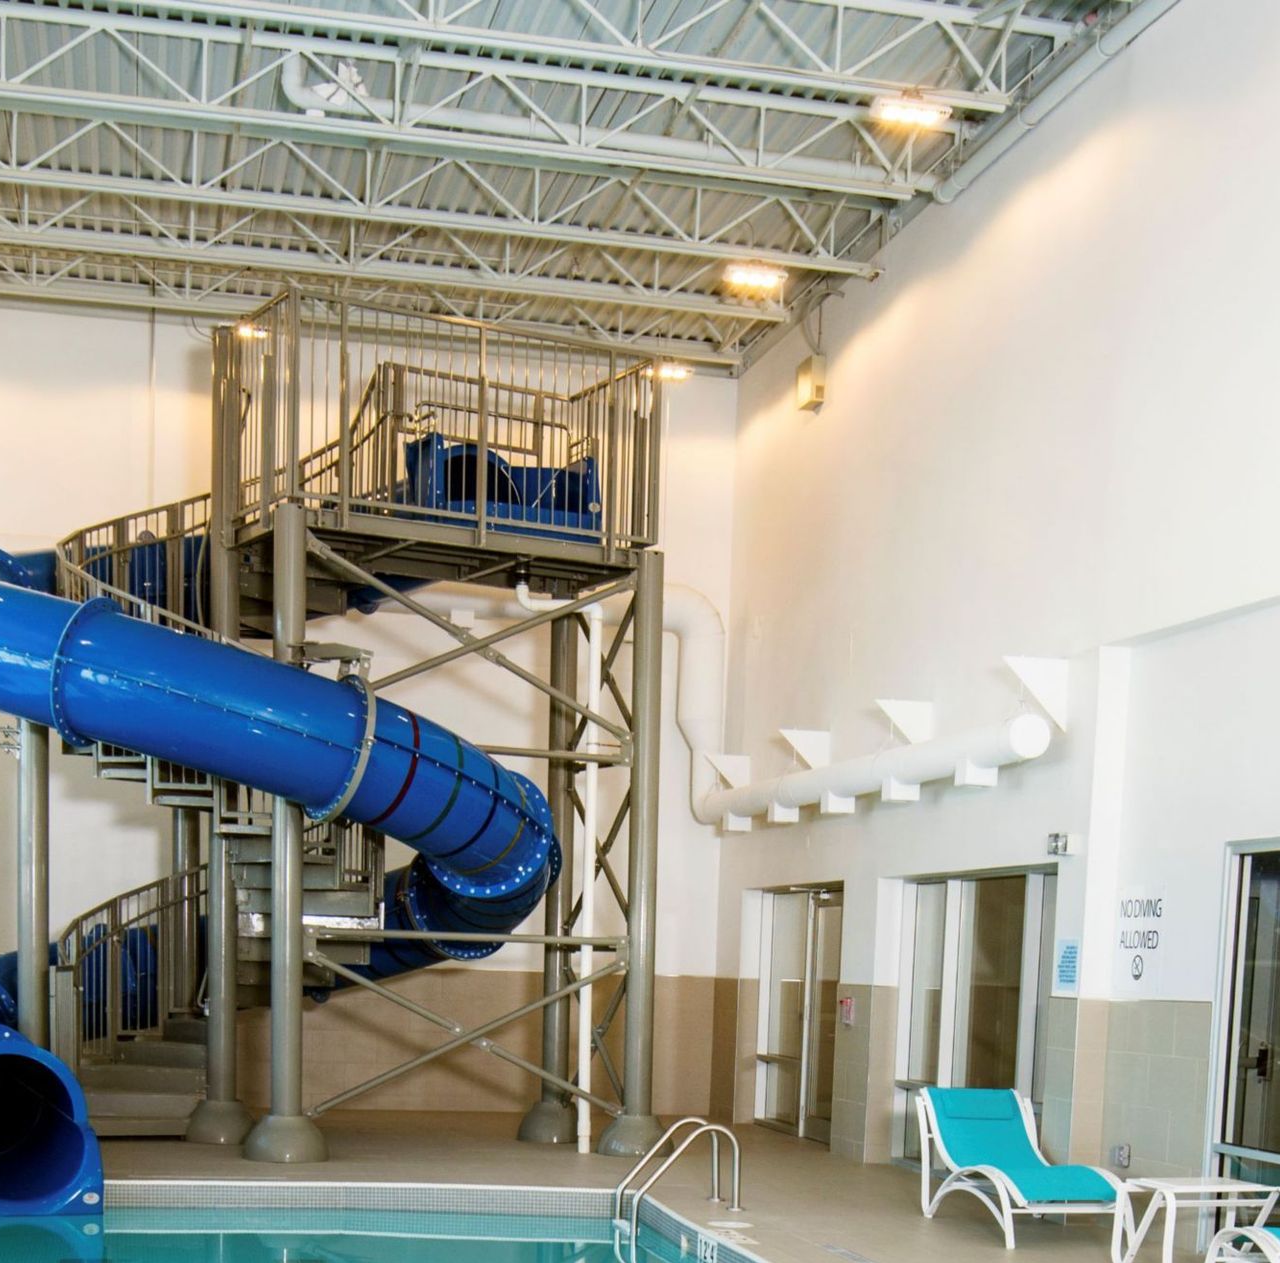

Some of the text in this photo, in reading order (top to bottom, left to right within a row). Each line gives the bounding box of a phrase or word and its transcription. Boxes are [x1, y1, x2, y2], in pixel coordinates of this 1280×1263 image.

[1120, 898, 1162, 918] NO DIVING
[1120, 930, 1159, 949] ALLOWED
